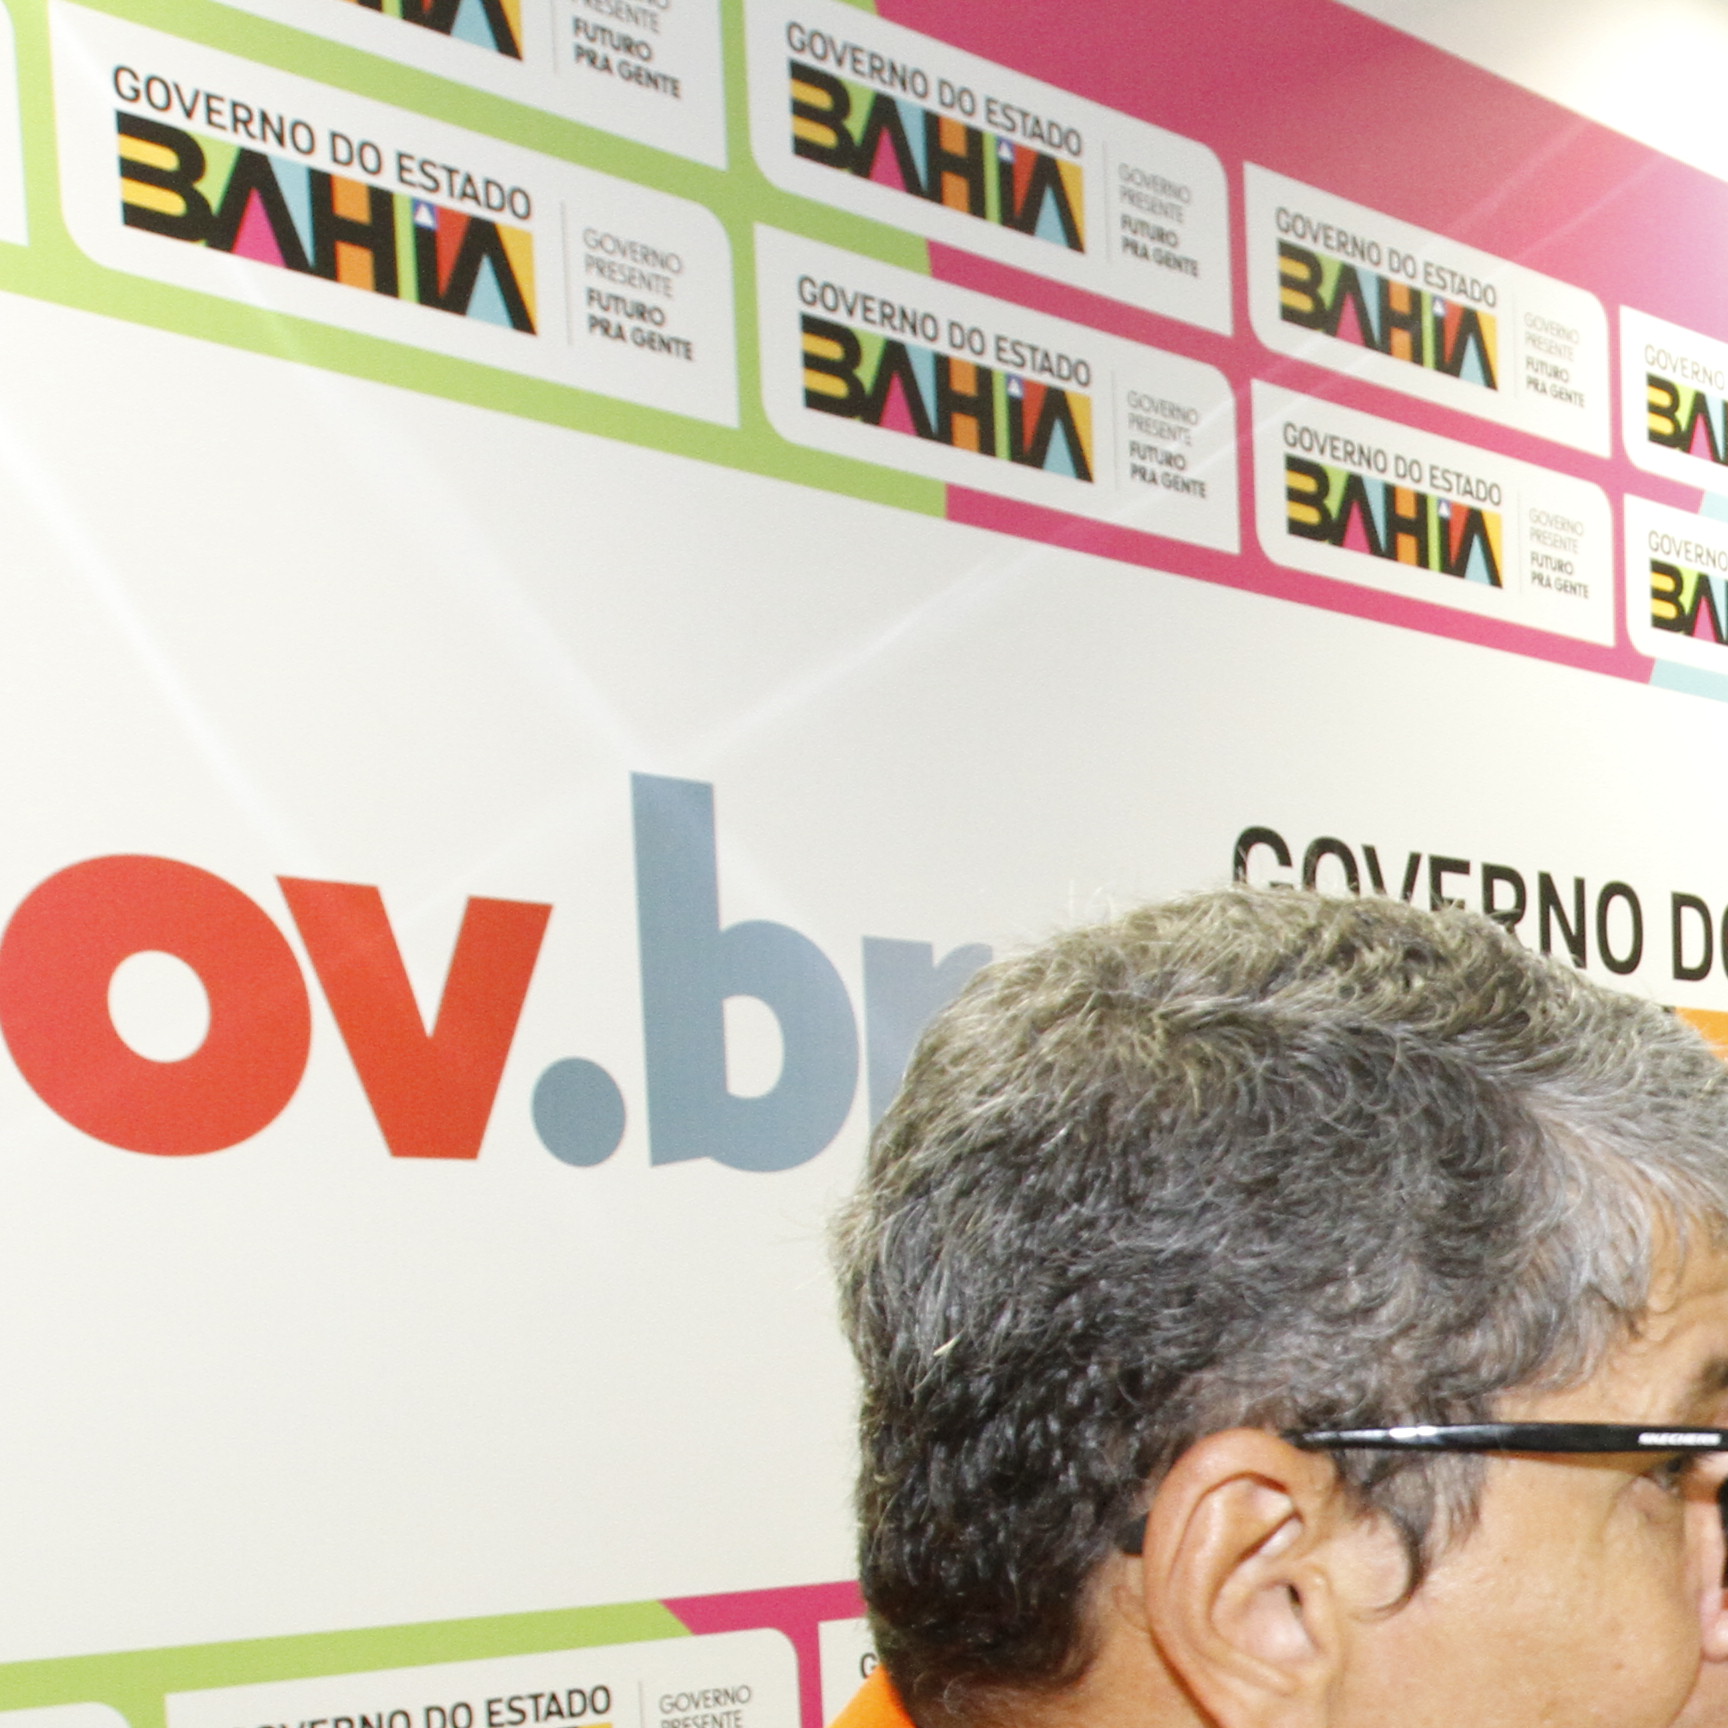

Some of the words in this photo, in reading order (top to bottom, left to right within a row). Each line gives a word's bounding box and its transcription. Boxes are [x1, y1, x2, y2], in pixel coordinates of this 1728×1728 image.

[576, 0, 660, 34] ESENTE
[571, 16, 652, 62] FUTURO
[572, 43, 613, 75] PRA
[616, 60, 682, 100] GENTE
[786, 21, 929, 99] GOVERNO
[938, 78, 976, 118] DO
[985, 96, 1083, 157] ESTADO
[112, 65, 315, 155] GOVERNO
[330, 130, 382, 175] DO
[397, 152, 532, 220] ESTADO
[789, 59, 1086, 255] BAHIA
[1118, 162, 1191, 204] GOVERNO
[114, 109, 538, 336] BAHIA
[1120, 186, 1184, 223] PRESENTE
[582, 228, 683, 274] GOVERNO
[1121, 214, 1179, 249] FUTURO
[585, 254, 674, 299] PRESENTE
[1122, 236, 1151, 262] PRA
[1153, 247, 1199, 278] GENTE
[1275, 206, 1382, 266] GOVERNO
[1388, 250, 1417, 280] DO
[1423, 262, 1498, 308] ESTADO
[586, 287, 666, 327] FUTURO
[1276, 237, 1499, 391] BAHIA
[1524, 311, 1580, 344] GOVERNO
[587, 314, 626, 342] PRA
[632, 326, 694, 362] GENTE
[797, 275, 939, 343] GOVERNO
[948, 318, 985, 355] DO
[996, 336, 1091, 387] ESTADO
[1525, 332, 1574, 361] PRESENTE
[1525, 357, 1570, 384] FUTURO
[1526, 375, 1550, 396] PRA
[1550, 383, 1585, 408] GENTE
[800, 310, 1095, 483] BAHIA
[1126, 390, 1199, 426] GOVERNO
[1128, 412, 1192, 446] PRESENTE
[1129, 443, 1187, 472] FUTURO
[1283, 421, 1388, 474] GOVERNO
[1394, 456, 1423, 484] DO
[1429, 468, 1503, 507] ESTADO
[1130, 463, 1160, 486] PRA
[1161, 472, 1207, 499] GENTE
[1283, 452, 1504, 590] BAHIA
[1529, 507, 1584, 536] GOVERNO
[1529, 527, 1579, 554] PRESENTE
[1529, 551, 1574, 575] FUTURO
[1648, 530, 1728, 572] GOVERNO
[1530, 570, 1554, 589] PRA
[1554, 576, 1590, 600] GENTE
[658, 1685, 753, 1715] GOVERNO
